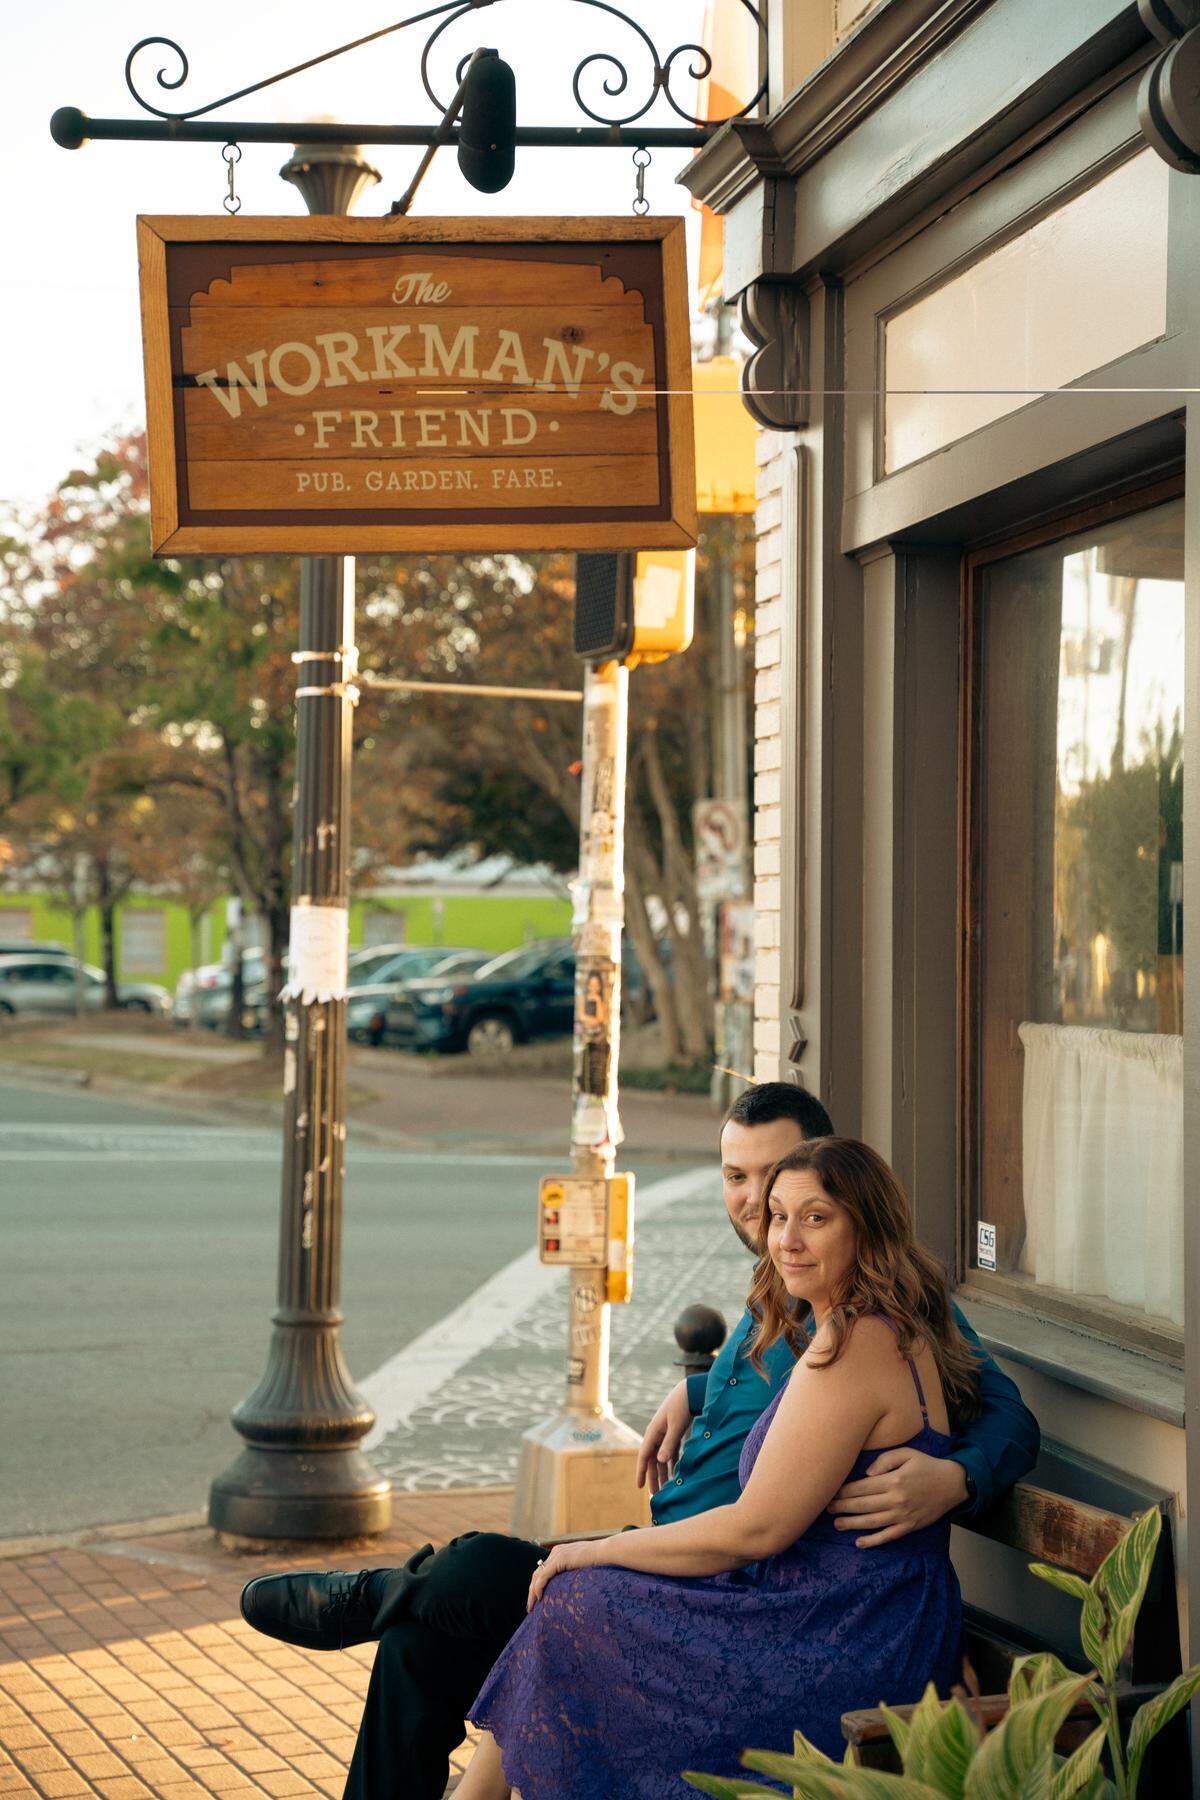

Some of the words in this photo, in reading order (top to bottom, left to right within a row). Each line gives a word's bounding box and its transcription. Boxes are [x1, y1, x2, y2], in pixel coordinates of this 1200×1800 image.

[392, 273, 452, 305] The
[195, 324, 645, 419] WORKMAN'S
[313, 408, 538, 449] FRIEND
[296, 473, 351, 492] PUB.
[366, 471, 478, 491] GARDEN.
[491, 469, 562, 489] FARE.
